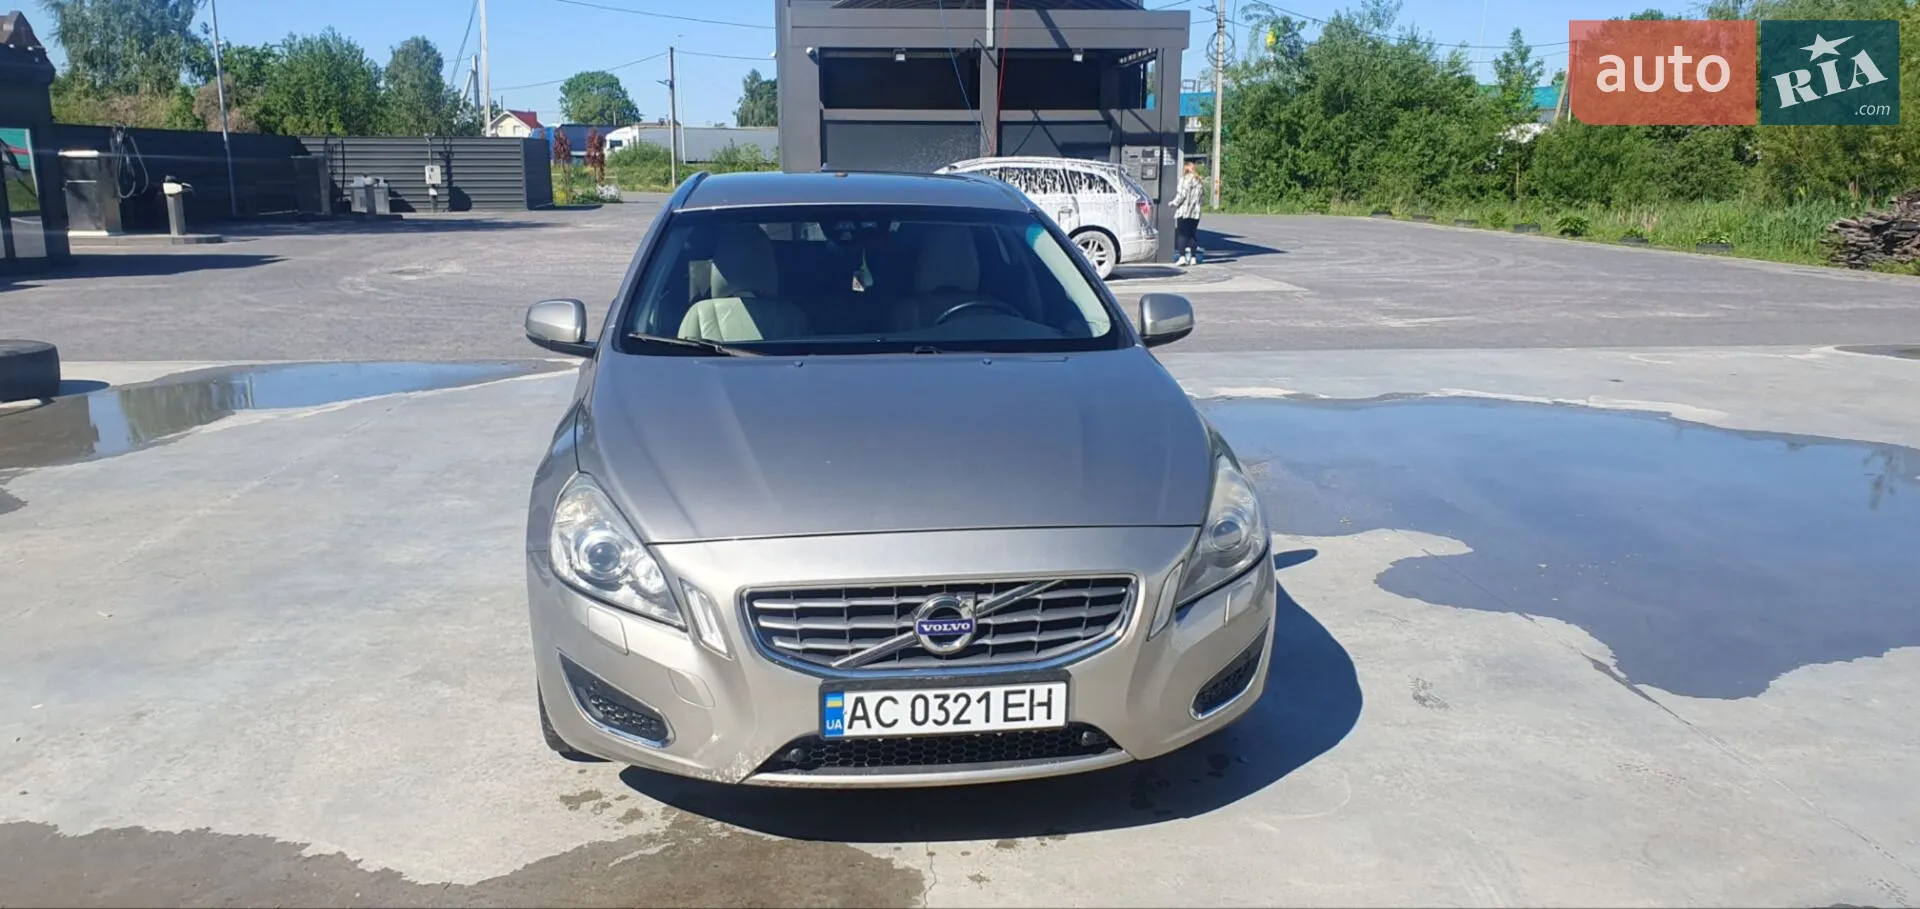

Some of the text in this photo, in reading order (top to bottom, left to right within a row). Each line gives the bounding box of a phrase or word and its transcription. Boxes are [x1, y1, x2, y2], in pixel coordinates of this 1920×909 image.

[921, 622, 971, 633] VOLVO
[847, 688, 1053, 730] AC 0321 EH
[826, 718, 843, 731] UA
